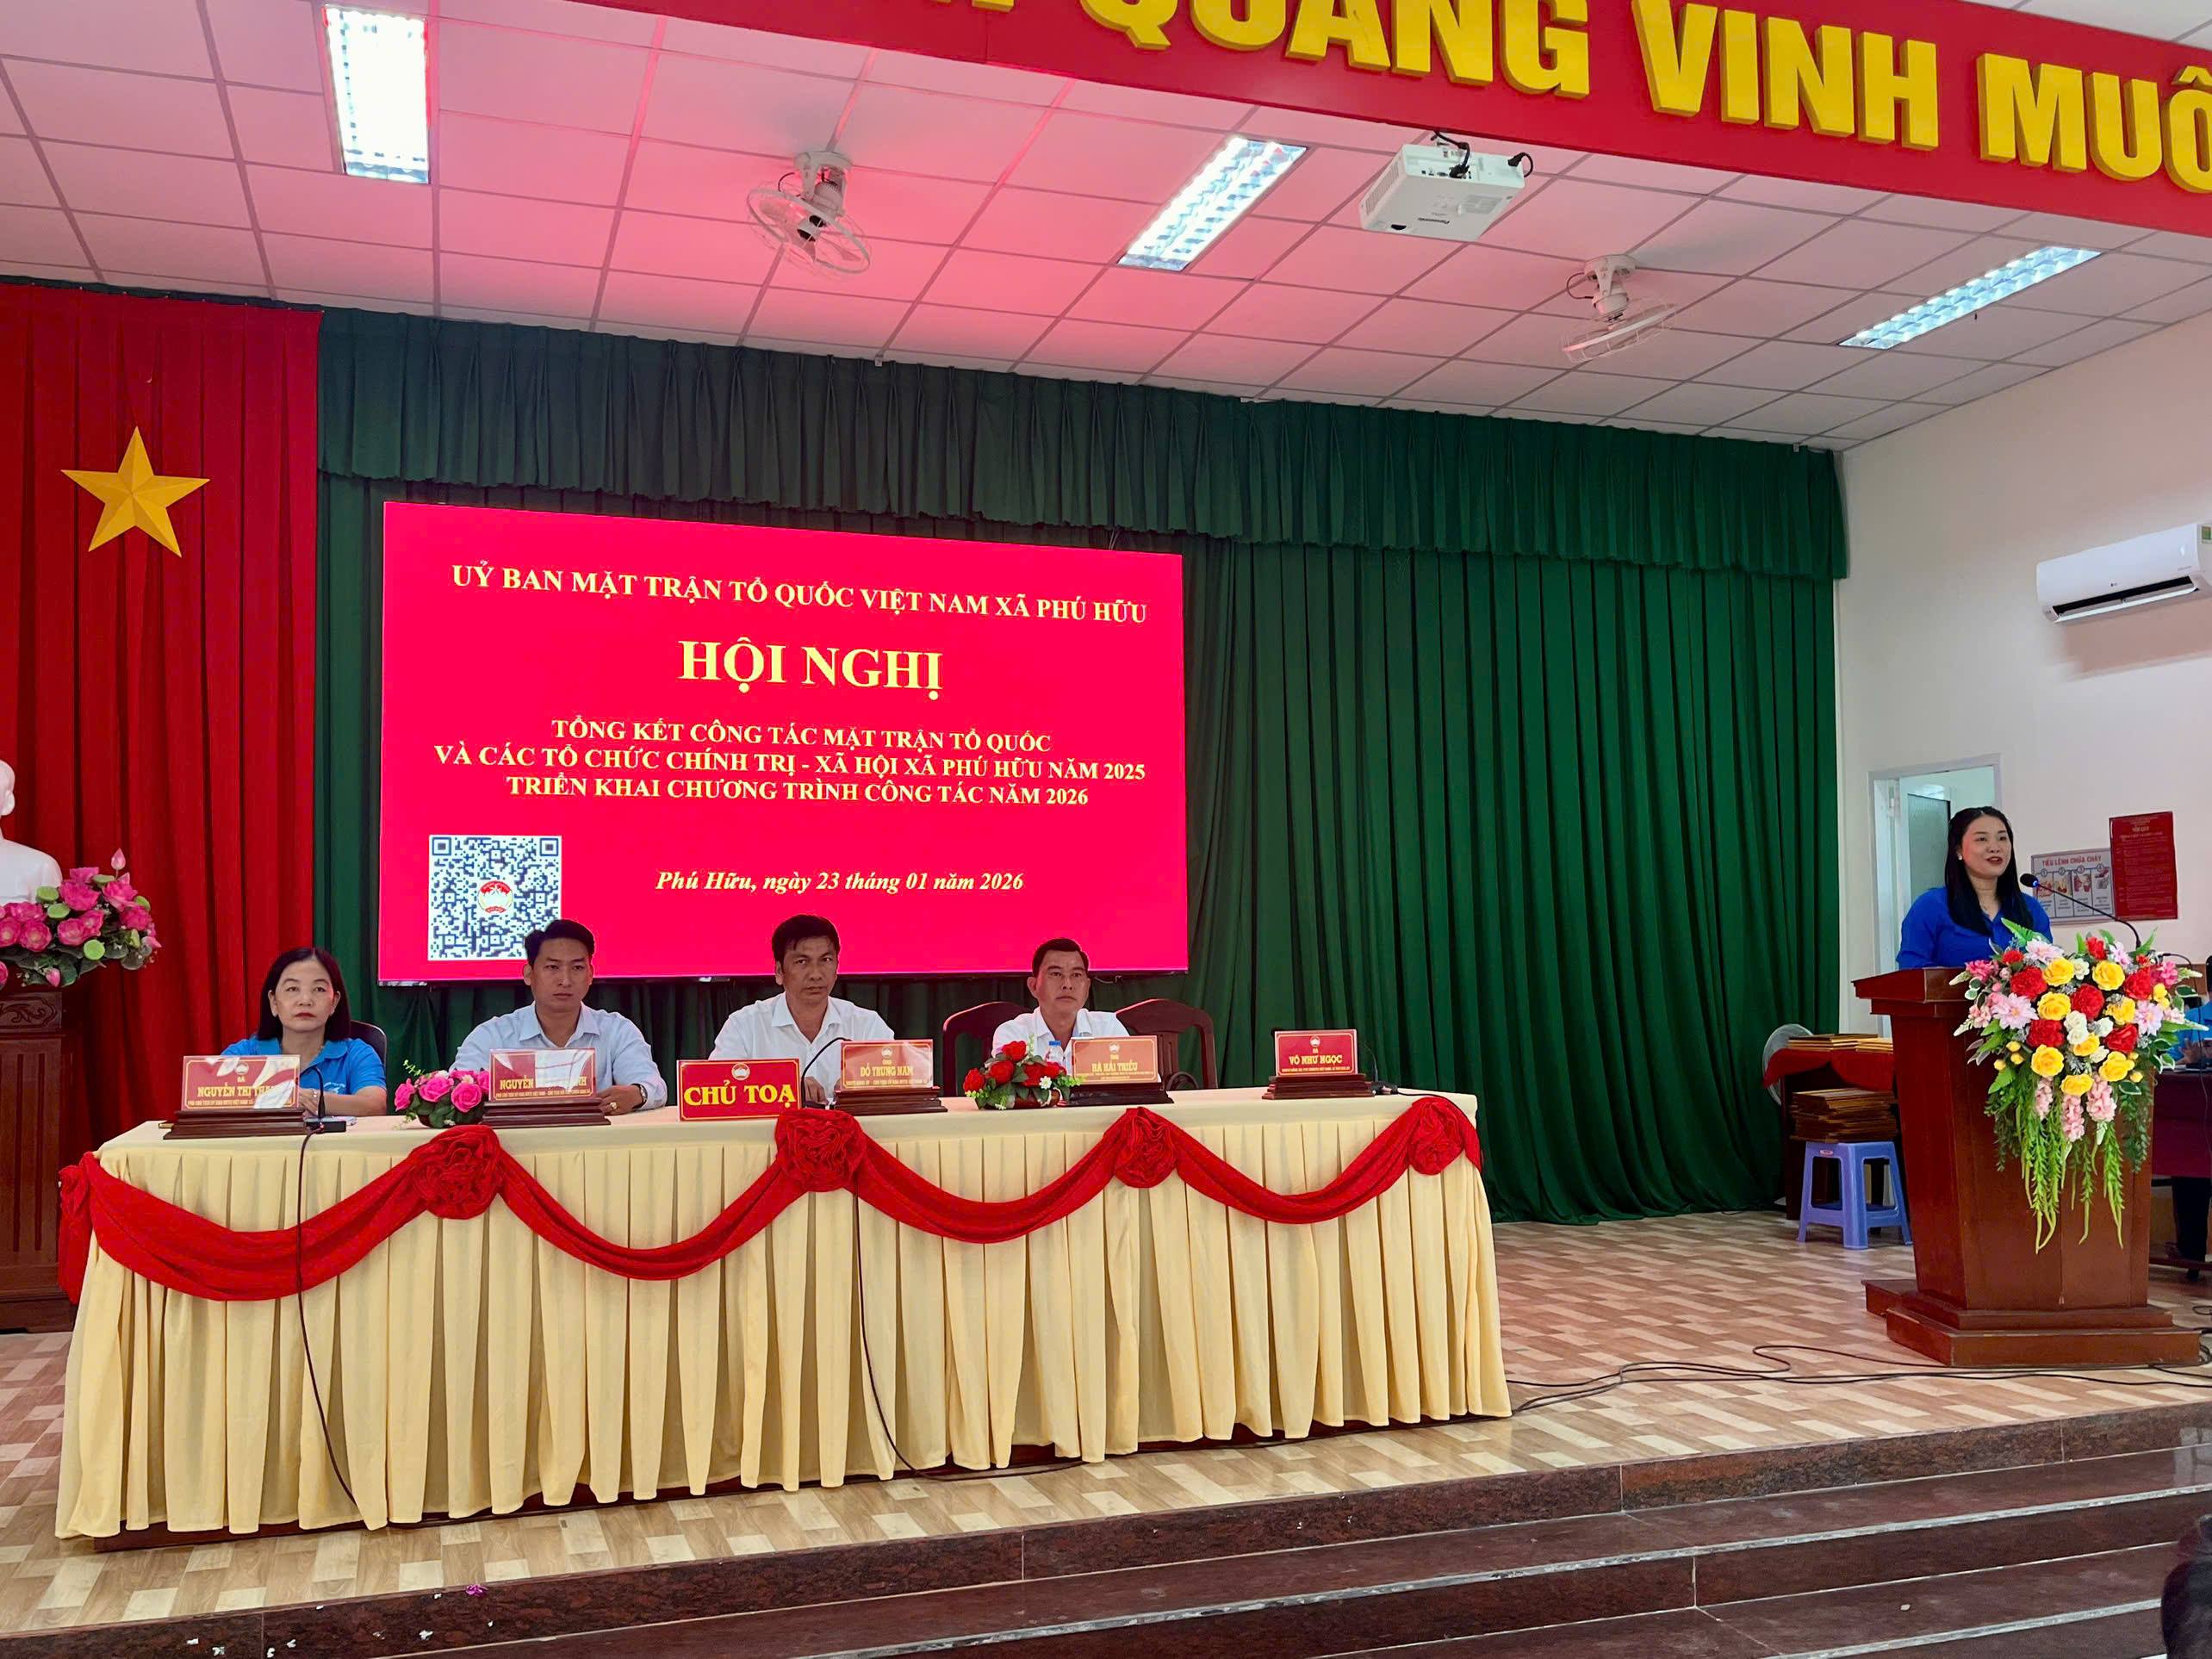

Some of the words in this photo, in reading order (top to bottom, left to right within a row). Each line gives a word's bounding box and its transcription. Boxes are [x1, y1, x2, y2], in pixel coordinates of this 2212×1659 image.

[1631, 0, 1938, 151] VINH
[452, 560, 494, 587] UỶ
[502, 569, 562, 591] BAN
[572, 571, 637, 600] MẶT
[643, 576, 722, 604] TRẬN
[729, 577, 767, 602] TỔ
[775, 581, 854, 607] QUỐC
[860, 588, 923, 615] VIỆT
[929, 593, 988, 614] NAM
[996, 593, 1030, 617] XÃ
[1036, 596, 1086, 620] PHÚ
[1093, 600, 1146, 623] HỮU
[678, 637, 786, 693] HỘI
[801, 647, 942, 700] NGHỊ
[551, 715, 626, 739] TỔNG
[633, 718, 684, 741] KẾT
[690, 719, 762, 743] CÔNG
[767, 723, 817, 744] TÁC
[823, 727, 876, 753] MẶT
[881, 730, 943, 753] TRẬN
[949, 728, 981, 750] TỔ
[987, 732, 1050, 754] QUỐC
[434, 741, 472, 765] VÀ
[479, 742, 535, 766] CÁC
[542, 744, 577, 767] TỔ
[585, 746, 660, 768] CHỨC
[667, 748, 748, 771] CHÍNH
[754, 754, 796, 777] TRỊ
[815, 752, 848, 774] XÃ
[854, 755, 898, 779] HỘI
[904, 755, 936, 775] XÃ
[942, 755, 988, 776] PHÚ
[994, 757, 1042, 778] HỮU
[1048, 758, 1098, 779] NĂM
[1104, 763, 1145, 780] 2025
[594, 779, 660, 797] KHAI
[668, 779, 777, 799] CHƯƠNG
[783, 778, 858, 800] TRÌNH
[865, 780, 932, 802] CÔNG
[937, 781, 983, 803] TÁC
[989, 784, 1041, 804] NĂM
[1046, 788, 1088, 805] 2026
[656, 871, 699, 889] Phú
[704, 872, 756, 892] Hữu,
[763, 872, 811, 894] ngày
[816, 872, 840, 889] 23
[845, 872, 900, 894] tháng
[906, 873, 927, 889] 01
[934, 873, 974, 889] năm
[979, 873, 1023, 890] 2026
[684, 1079, 736, 1106] CHỦ
[743, 1084, 797, 1109] TOẠ
